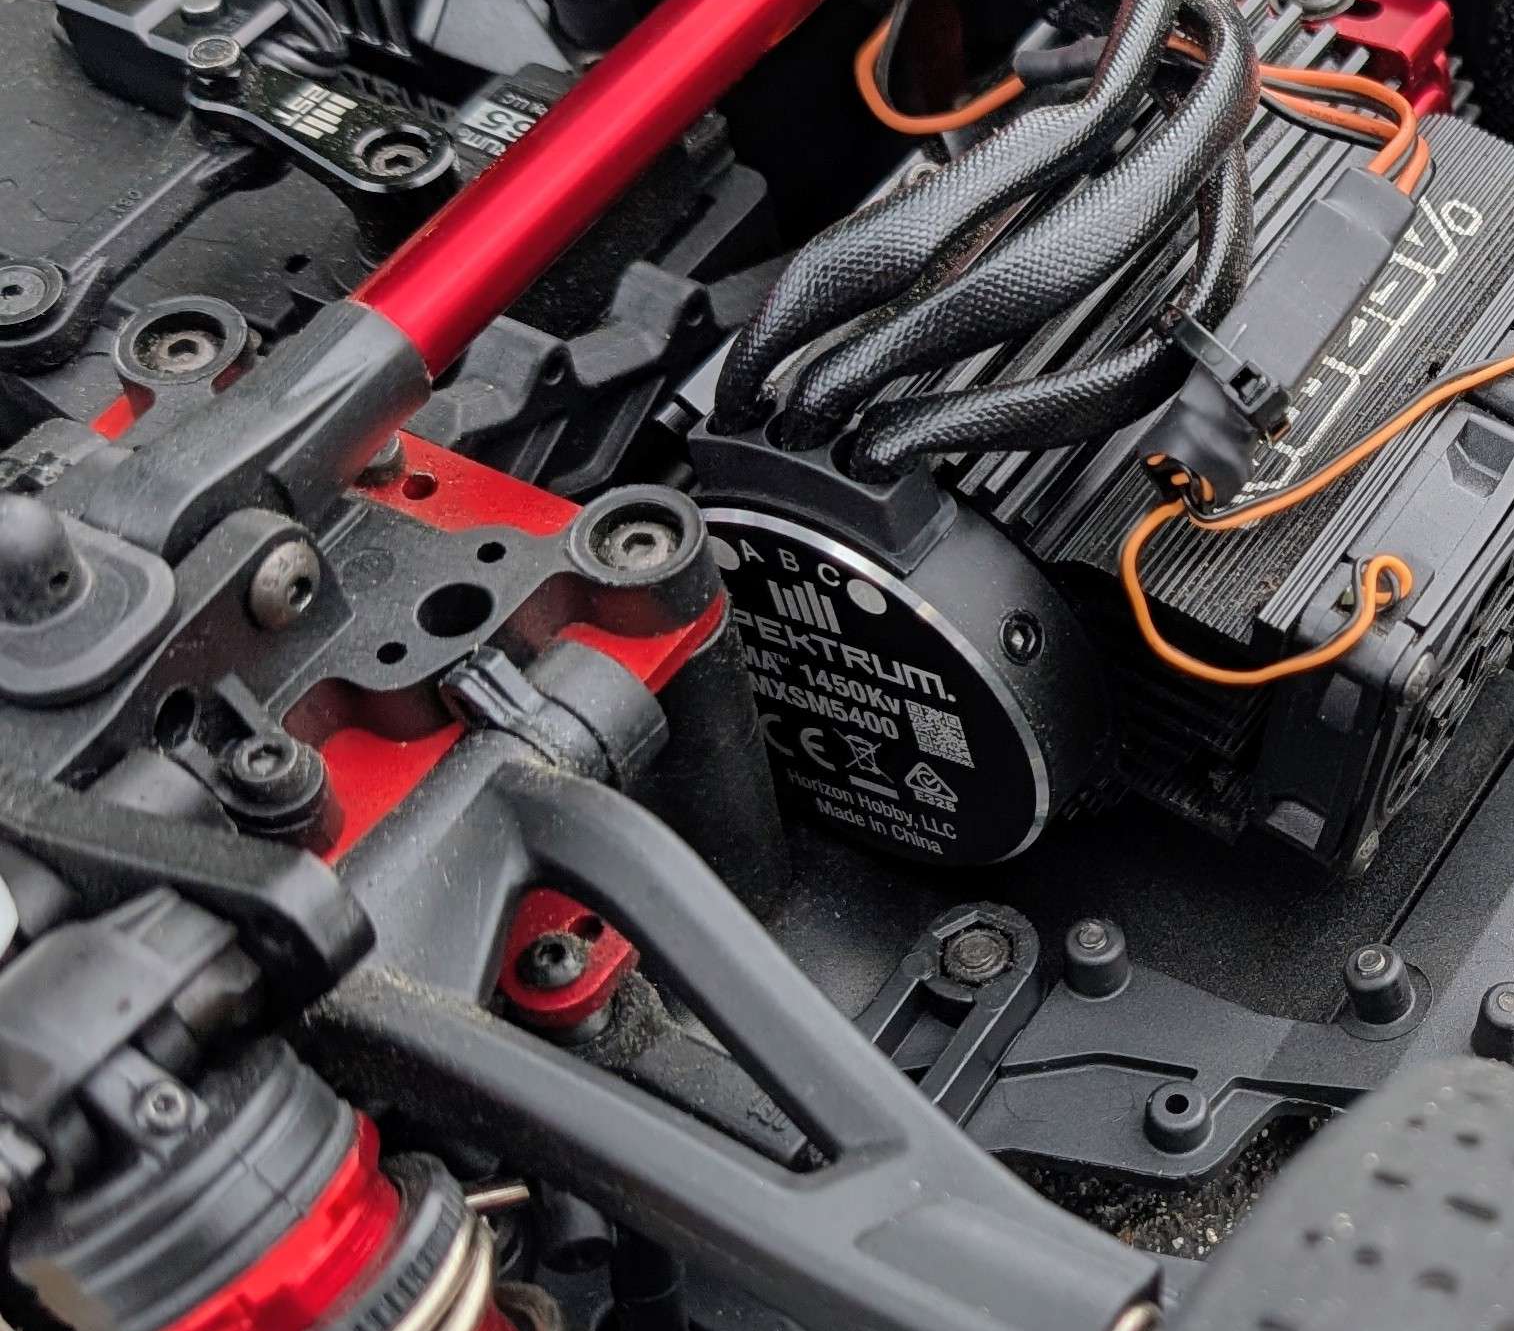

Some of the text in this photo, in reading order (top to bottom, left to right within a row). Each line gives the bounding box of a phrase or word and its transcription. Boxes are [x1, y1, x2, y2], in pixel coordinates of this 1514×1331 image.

[739, 538, 841, 588] A B C
[799, 663, 901, 716] 1450Kv
[787, 767, 958, 841] Horizon Hobby, LLC
[815, 796, 866, 829] Made
[890, 820, 944, 856] China
